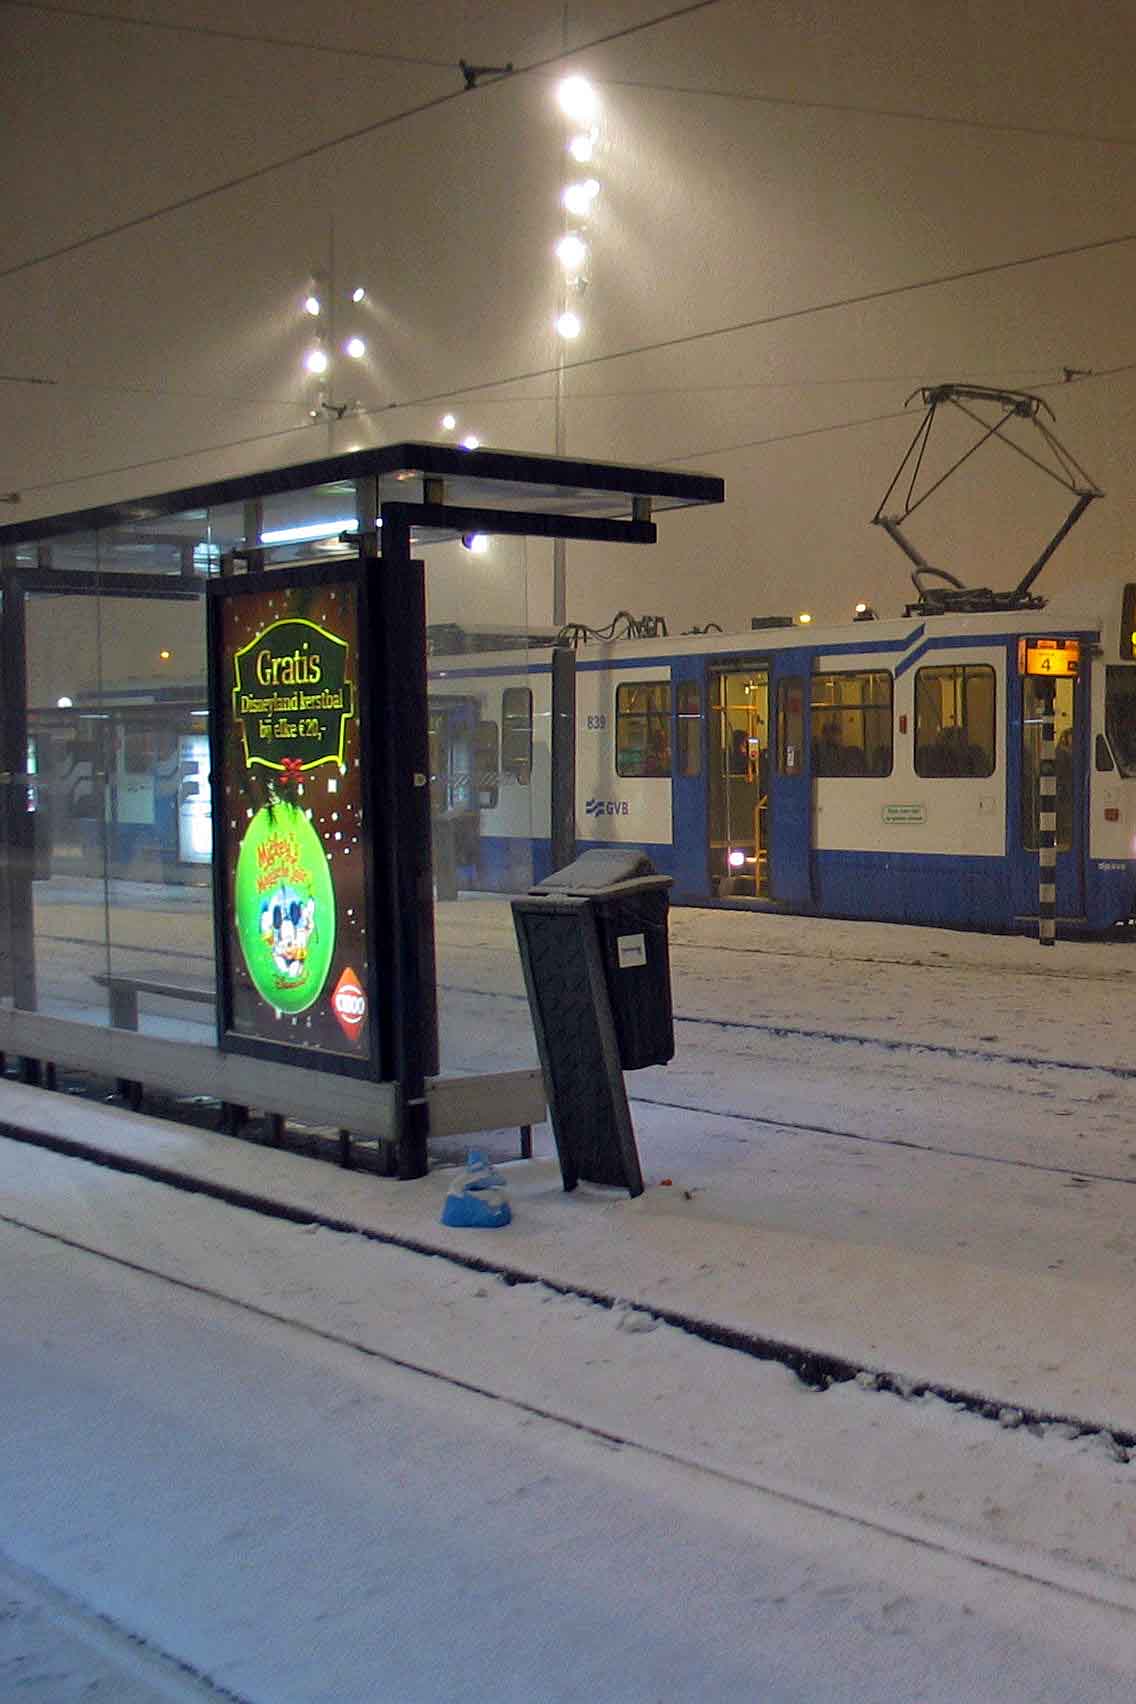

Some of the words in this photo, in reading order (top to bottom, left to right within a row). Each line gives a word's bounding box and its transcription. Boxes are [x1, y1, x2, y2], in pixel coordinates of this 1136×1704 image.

[257, 643, 321, 686] Gratis
[240, 692, 298, 717] Disneyland
[300, 688, 343, 710] kerstbal
[274, 718, 297, 738] elke
[587, 715, 606, 729] 839
[606, 801, 629, 815] GVB
